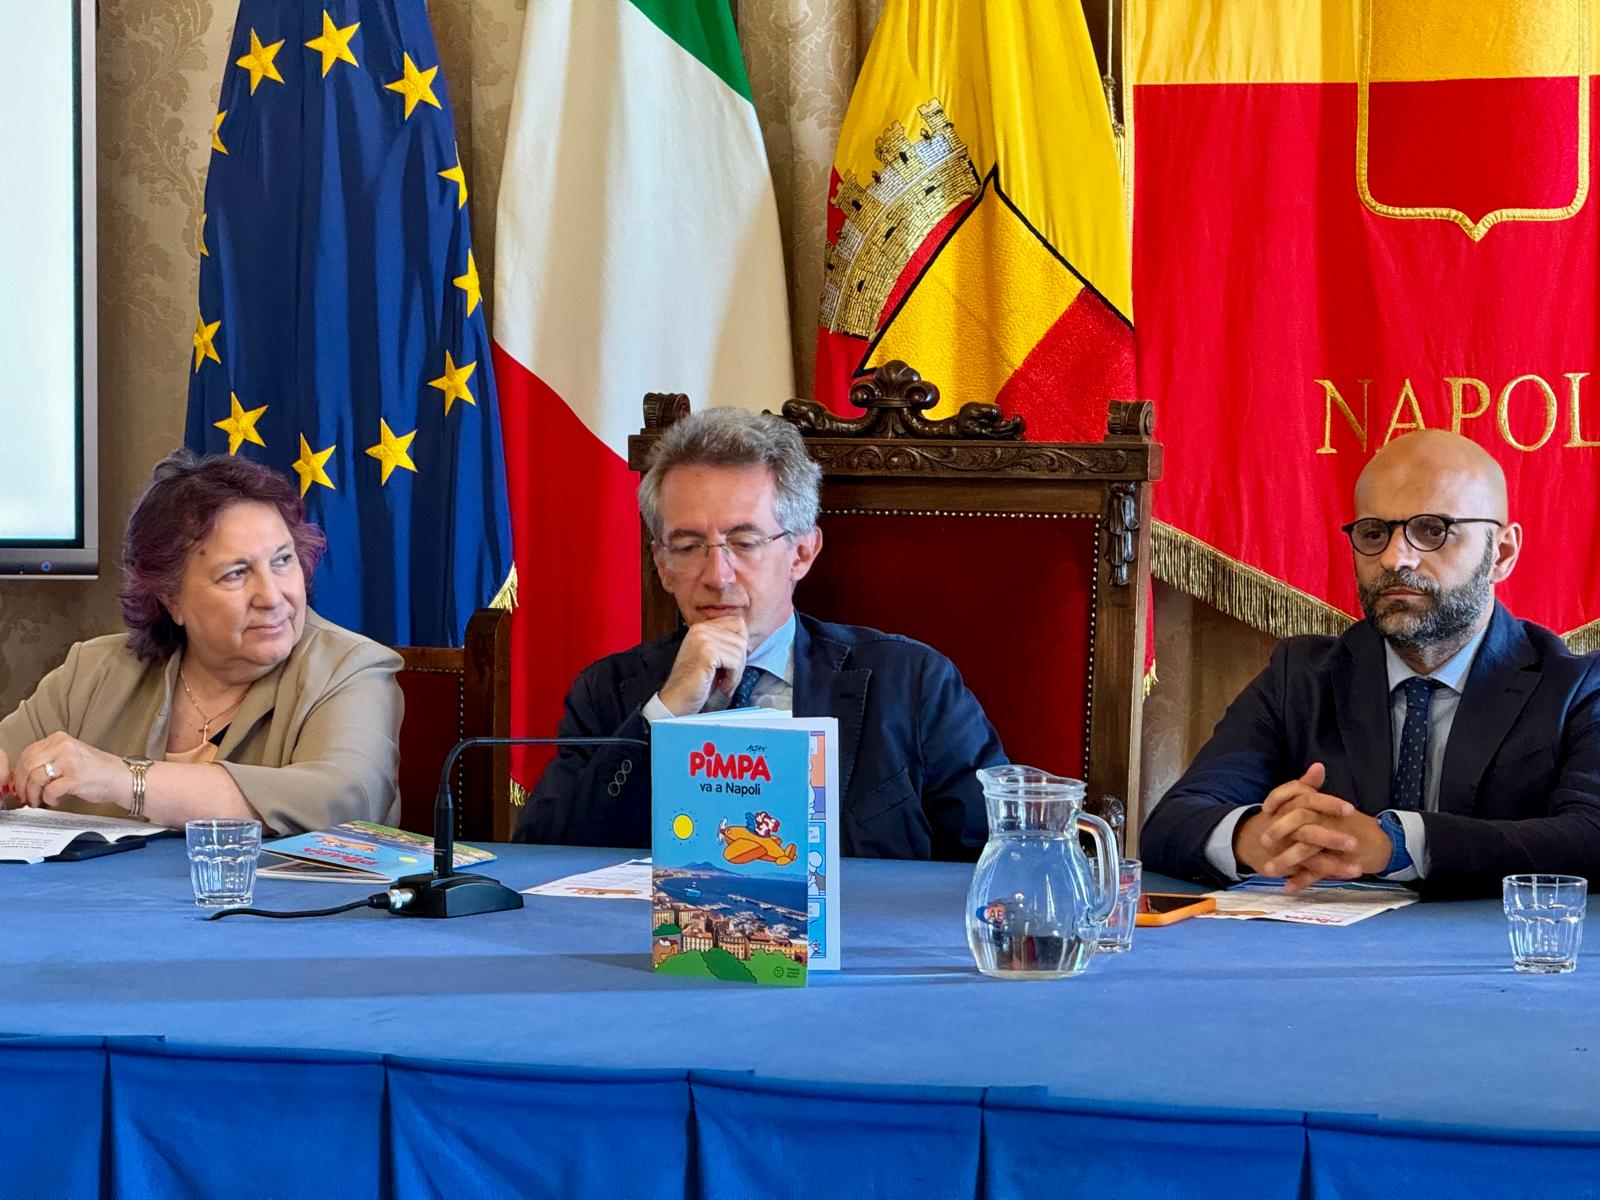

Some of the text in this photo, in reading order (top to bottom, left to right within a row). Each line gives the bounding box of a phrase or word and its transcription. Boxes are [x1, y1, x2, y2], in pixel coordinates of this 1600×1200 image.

[700, 782, 761, 797] va a Napoli
